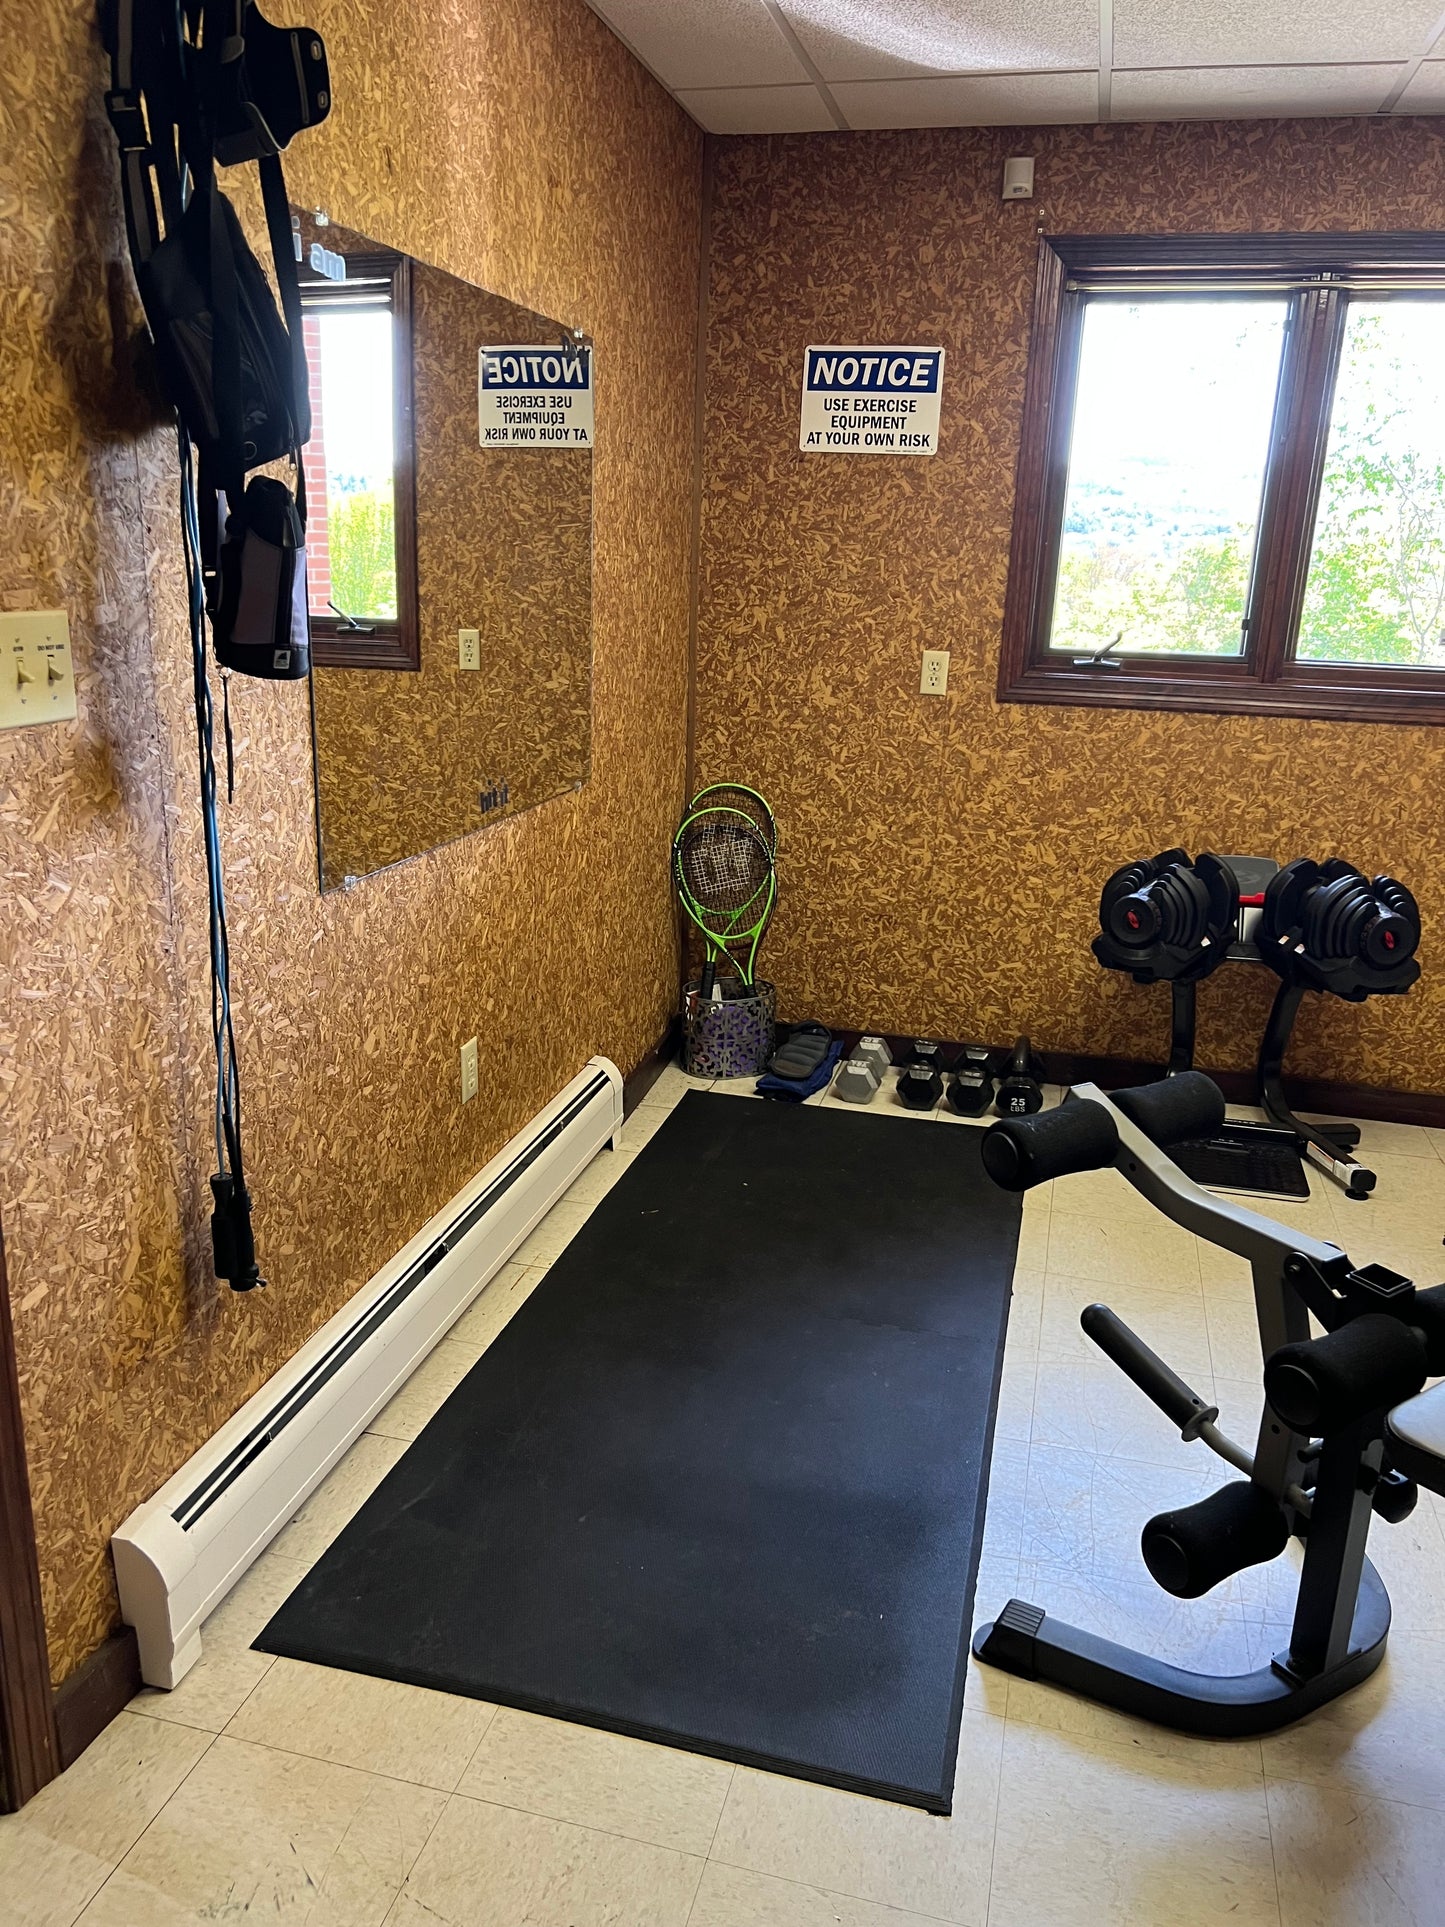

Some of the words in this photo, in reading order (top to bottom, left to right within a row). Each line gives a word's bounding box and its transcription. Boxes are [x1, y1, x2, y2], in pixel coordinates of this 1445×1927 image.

[310, 243, 346, 282] am
[812, 357, 934, 386] NOTICE
[823, 398, 850, 412] USE
[853, 398, 918, 413] EXERCISE
[830, 415, 908, 431] EQUIPMENT
[806, 432, 823, 445] AT
[825, 432, 860, 446] YOUR
[864, 433, 895, 446] OWN
[899, 434, 931, 447] RISK
[1011, 1097, 1026, 1106] 25
